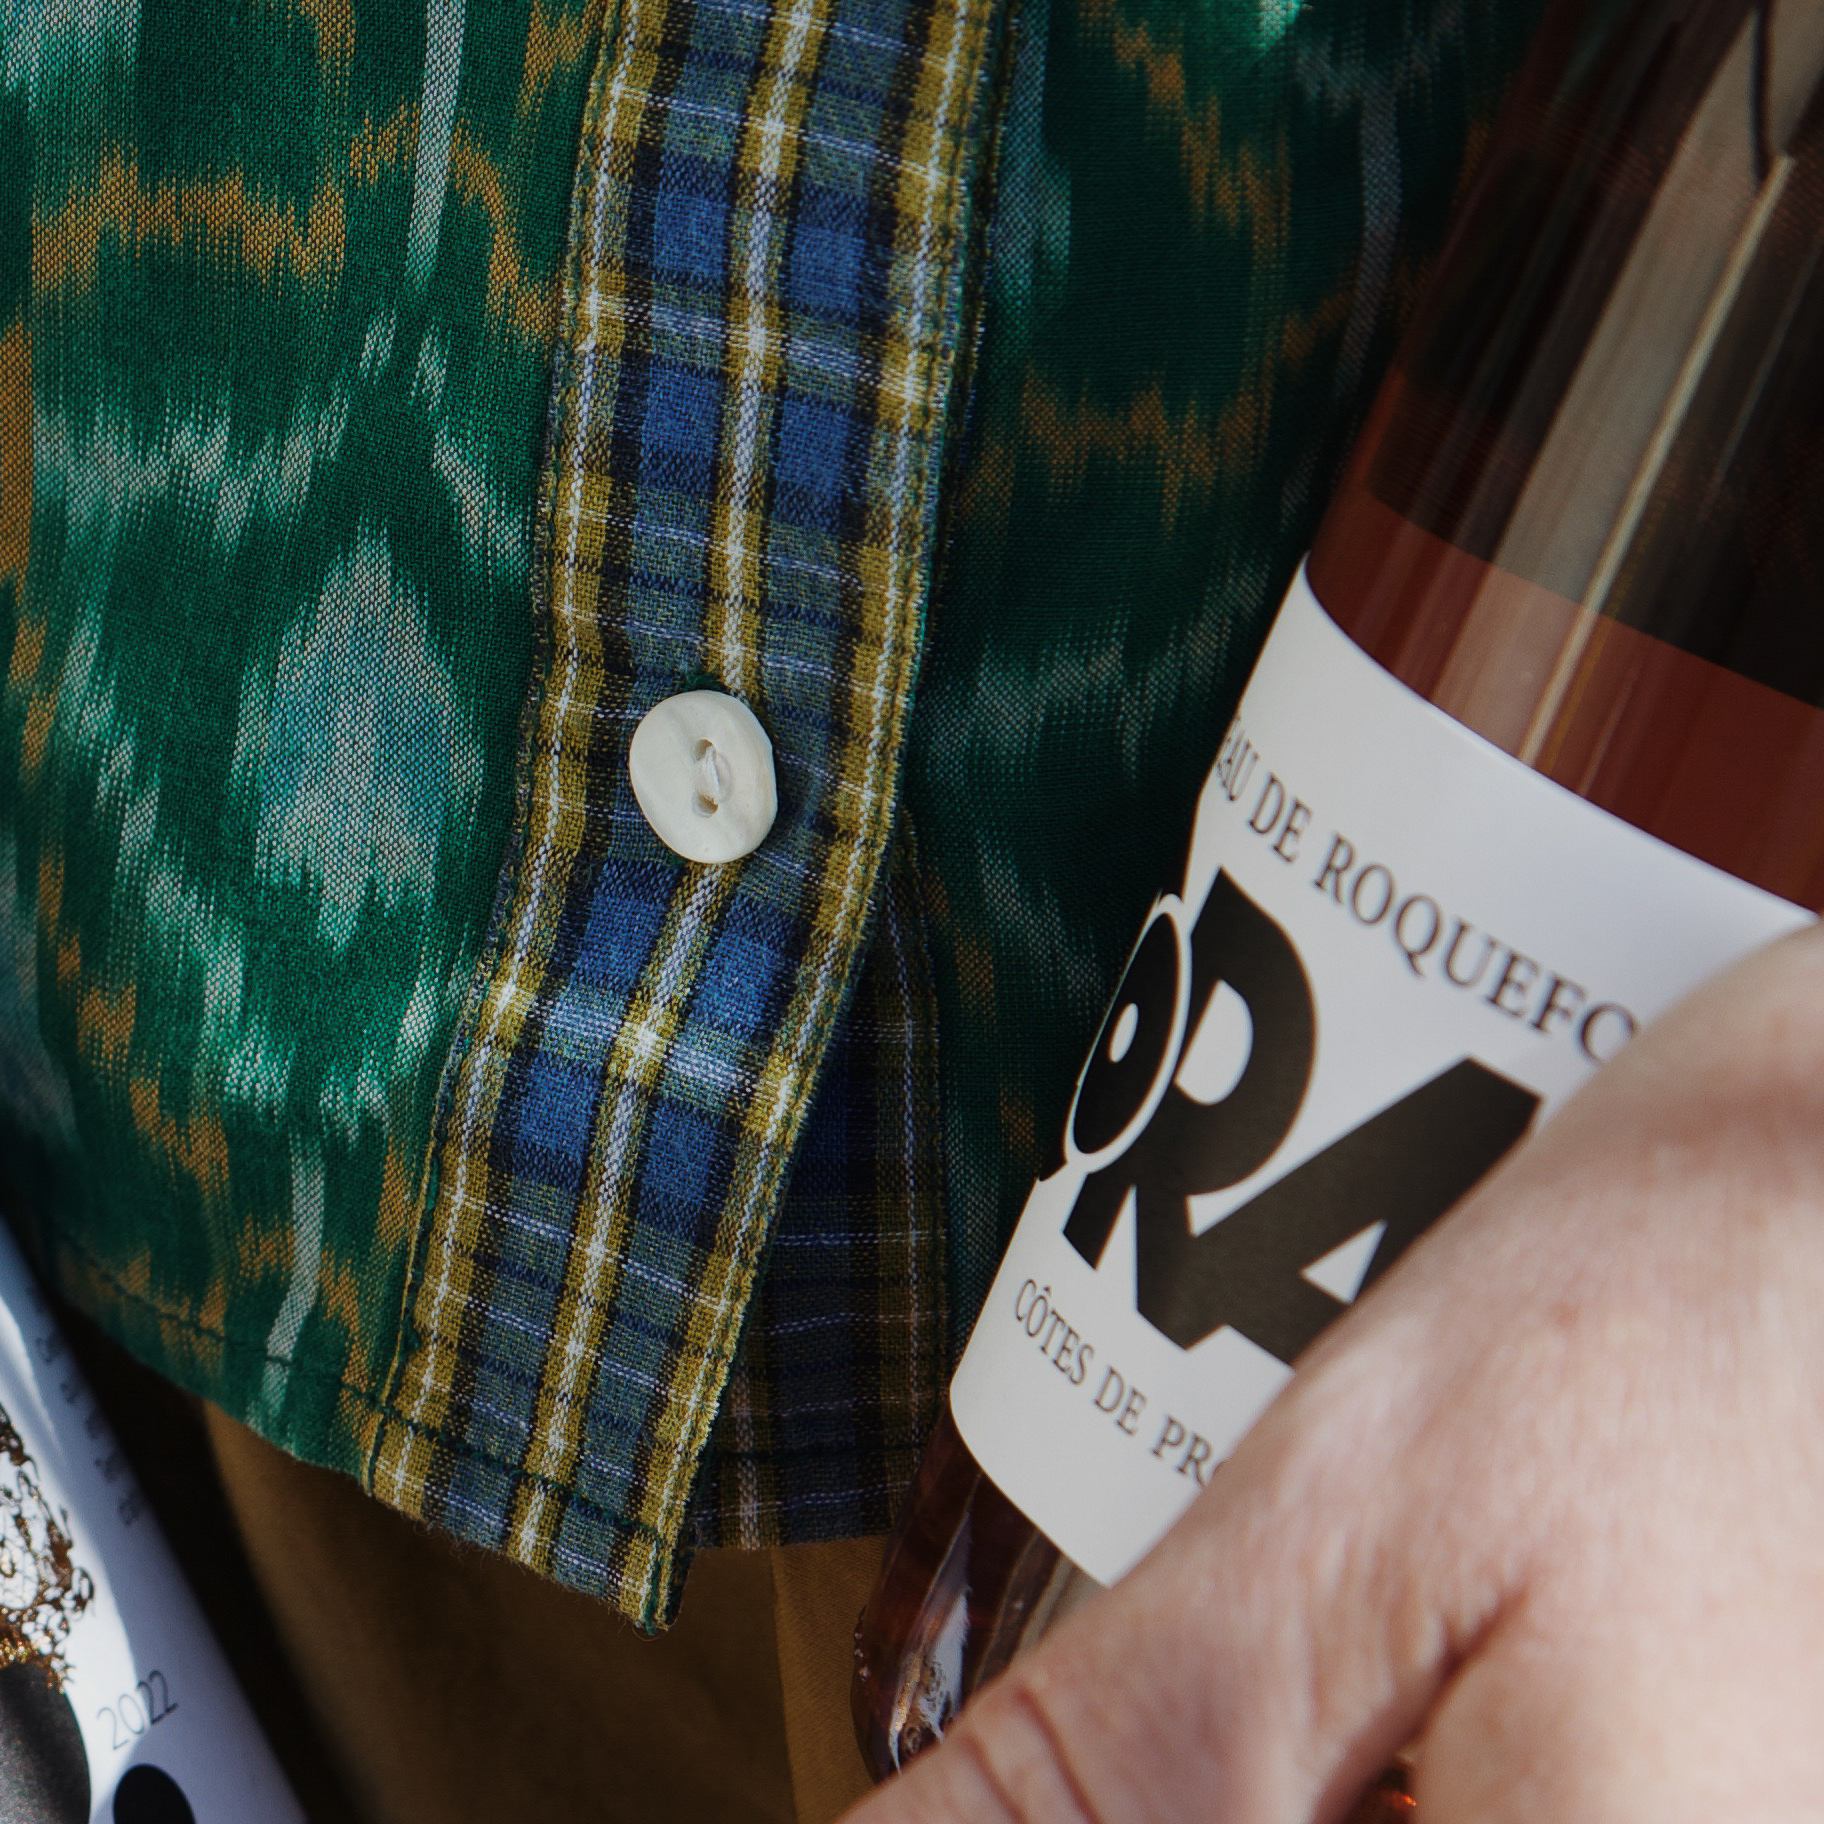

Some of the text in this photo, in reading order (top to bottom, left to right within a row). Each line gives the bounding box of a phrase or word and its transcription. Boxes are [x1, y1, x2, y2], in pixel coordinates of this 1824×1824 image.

[1247, 771, 1313, 864] DE
[1014, 1278, 1228, 1489] CÔTES DE PR
[95, 1670, 180, 1751] 2022
